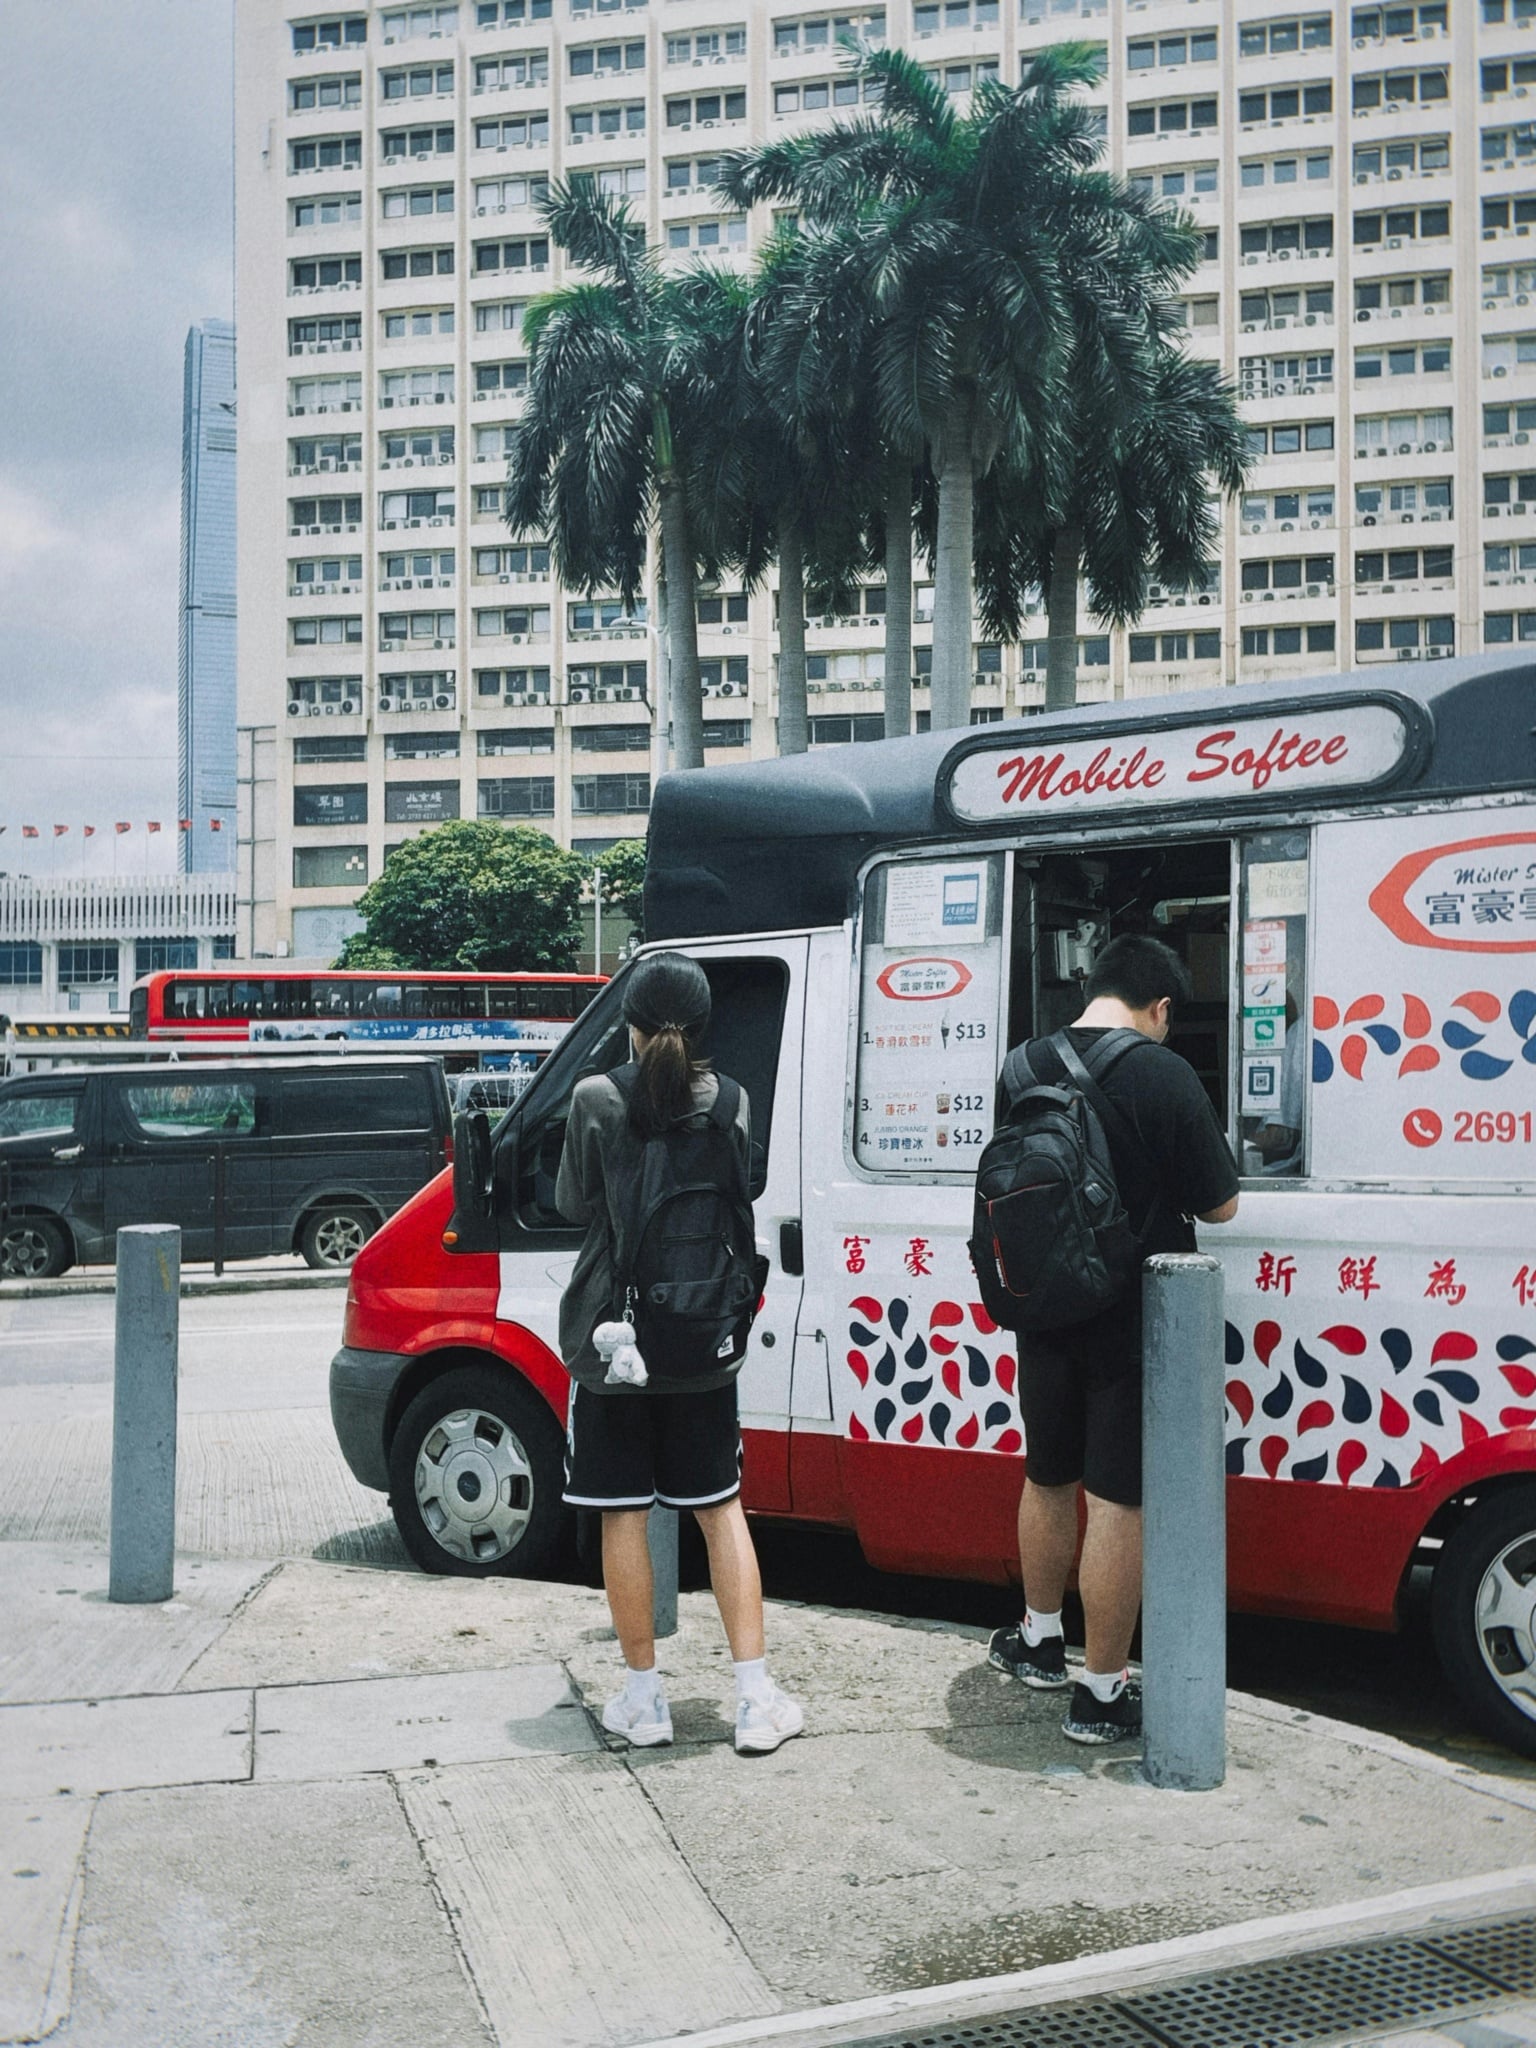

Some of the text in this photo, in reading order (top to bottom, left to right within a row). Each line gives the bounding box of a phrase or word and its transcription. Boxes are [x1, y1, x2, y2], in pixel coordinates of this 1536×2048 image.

[997, 728, 1349, 804] Mobile Softee
[1454, 866, 1518, 885] Mister
[863, 1032, 874, 1044] 1.
[956, 1022, 986, 1041] $13
[861, 1099, 872, 1111] 3.
[953, 1094, 983, 1113] $12
[953, 1127, 983, 1146] $12
[1454, 1111, 1532, 1143] 2691
[860, 1133, 871, 1144] 4.
[843, 1235, 977, 1277] 富豪
